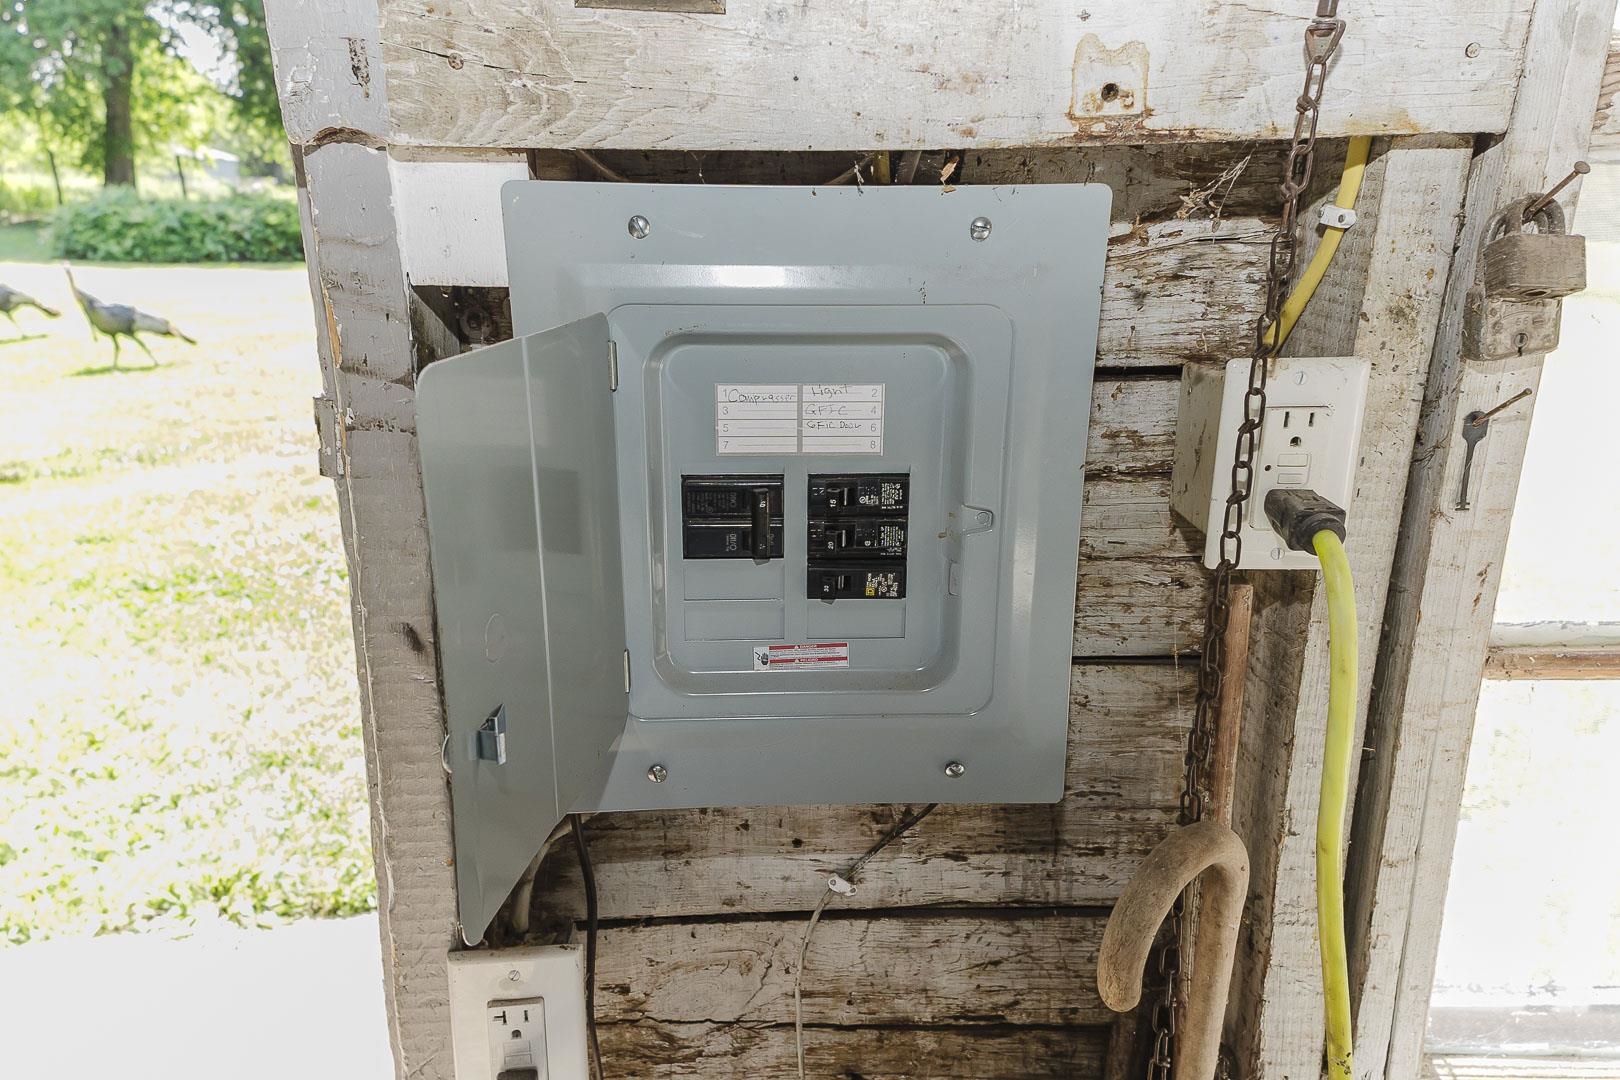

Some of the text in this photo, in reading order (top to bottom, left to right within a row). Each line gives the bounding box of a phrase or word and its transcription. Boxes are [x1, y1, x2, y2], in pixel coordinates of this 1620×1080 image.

[871, 388, 878, 398] 2
[722, 406, 729, 416] 3
[870, 405, 877, 415] 4
[722, 423, 729, 433] 5
[870, 423, 877, 432] 6
[723, 440, 729, 449] 7
[870, 440, 876, 449] 8
[829, 499, 837, 508] 15
